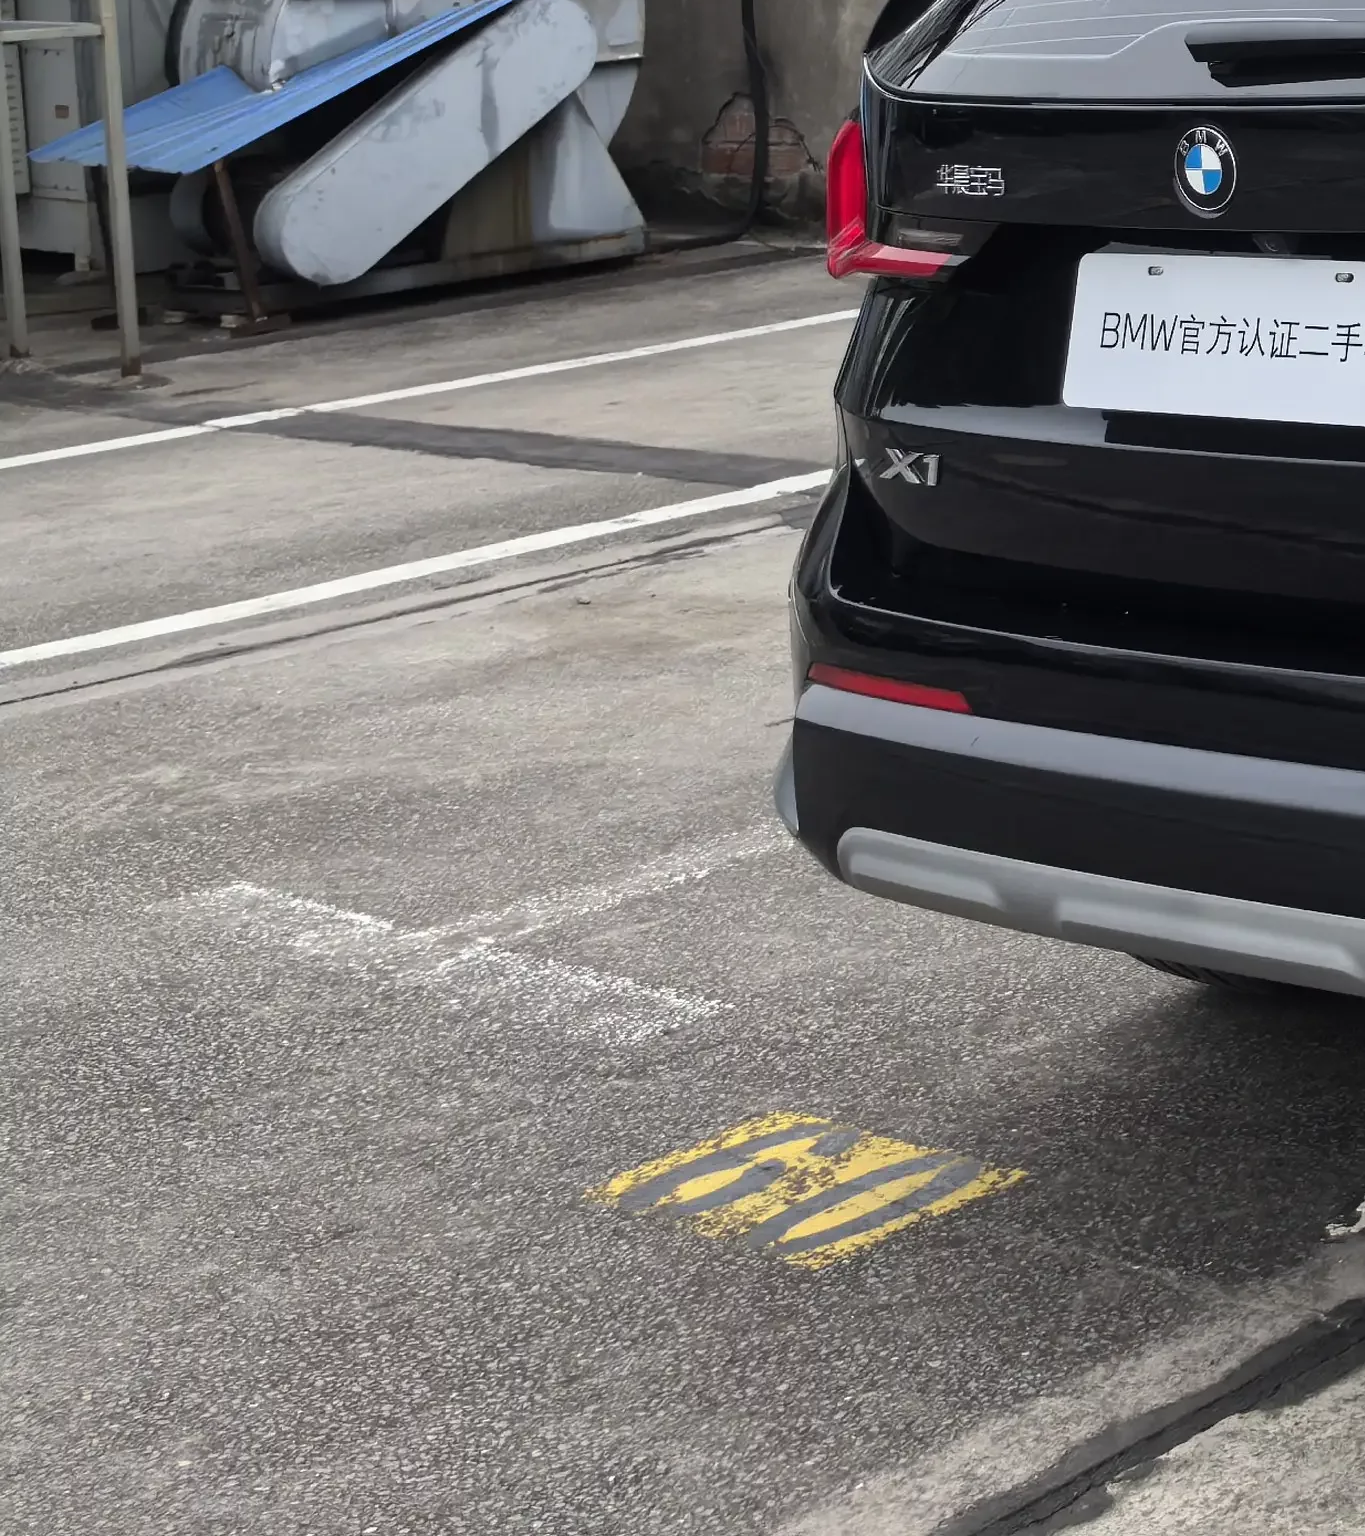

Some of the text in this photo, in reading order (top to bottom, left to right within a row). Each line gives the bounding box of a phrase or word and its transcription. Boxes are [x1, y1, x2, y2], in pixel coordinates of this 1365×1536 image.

[1179, 130, 1229, 157] BMW
[936, 164, 1005, 196] 华晨宝马
[880, 447, 941, 486] X1
